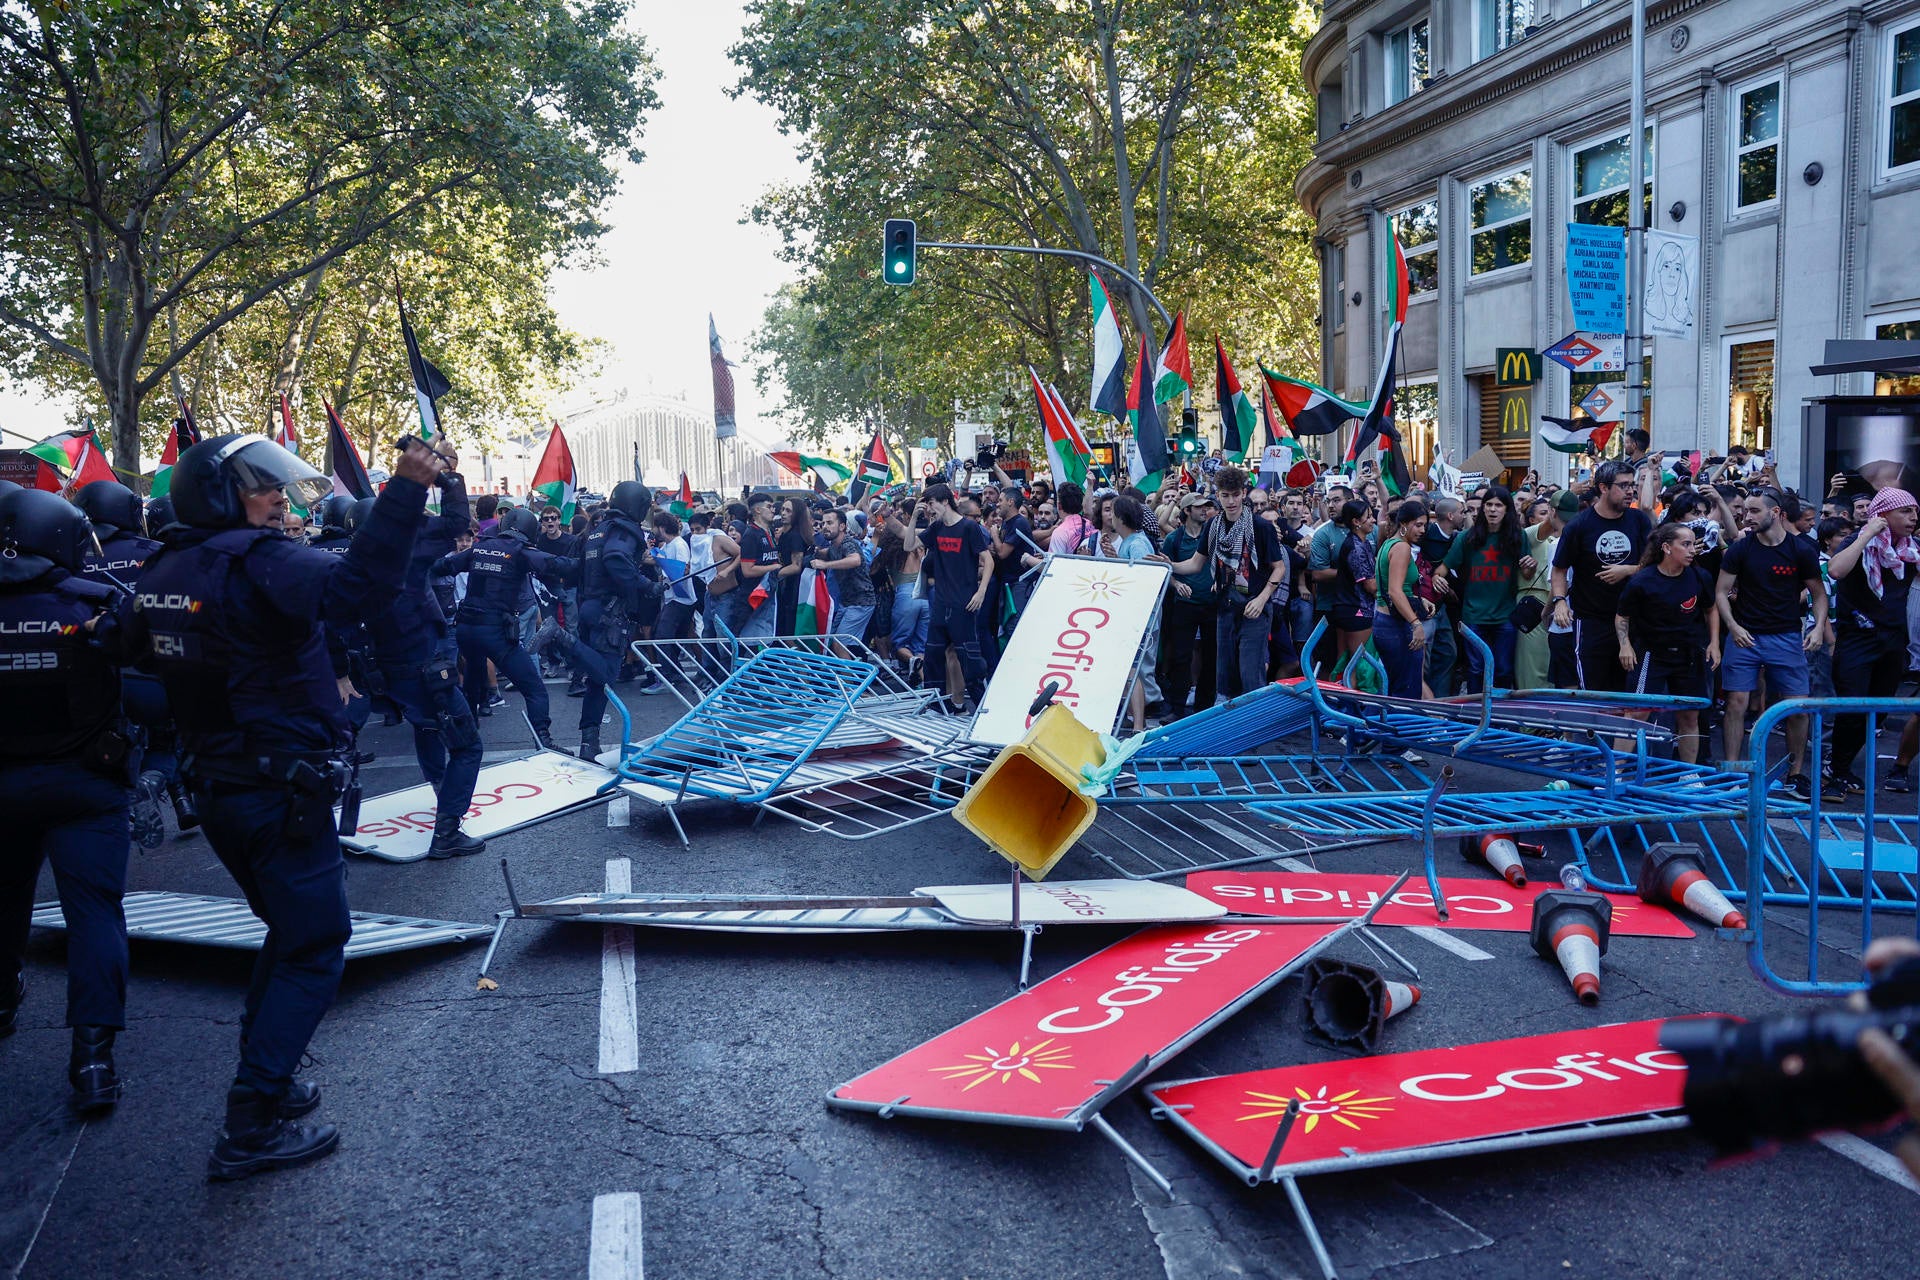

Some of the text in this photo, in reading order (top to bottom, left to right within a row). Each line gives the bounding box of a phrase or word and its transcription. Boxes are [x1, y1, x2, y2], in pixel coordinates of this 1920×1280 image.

[1570, 237, 1589, 247] MICHEL
[1574, 249, 1596, 258] ADRIANA
[1582, 260, 1600, 269] CAMILA
[1573, 270, 1597, 279] MICHAEL
[1579, 281, 1604, 290] HARTMUT
[473, 549, 505, 558] POLICIA
[83, 559, 139, 573] OLICIA
[0, 620, 63, 634] LICIA
[1037, 887, 1107, 916] ofidis
[1212, 884, 1514, 914] Cofidis
[1036, 929, 1261, 1034] Cofidis
